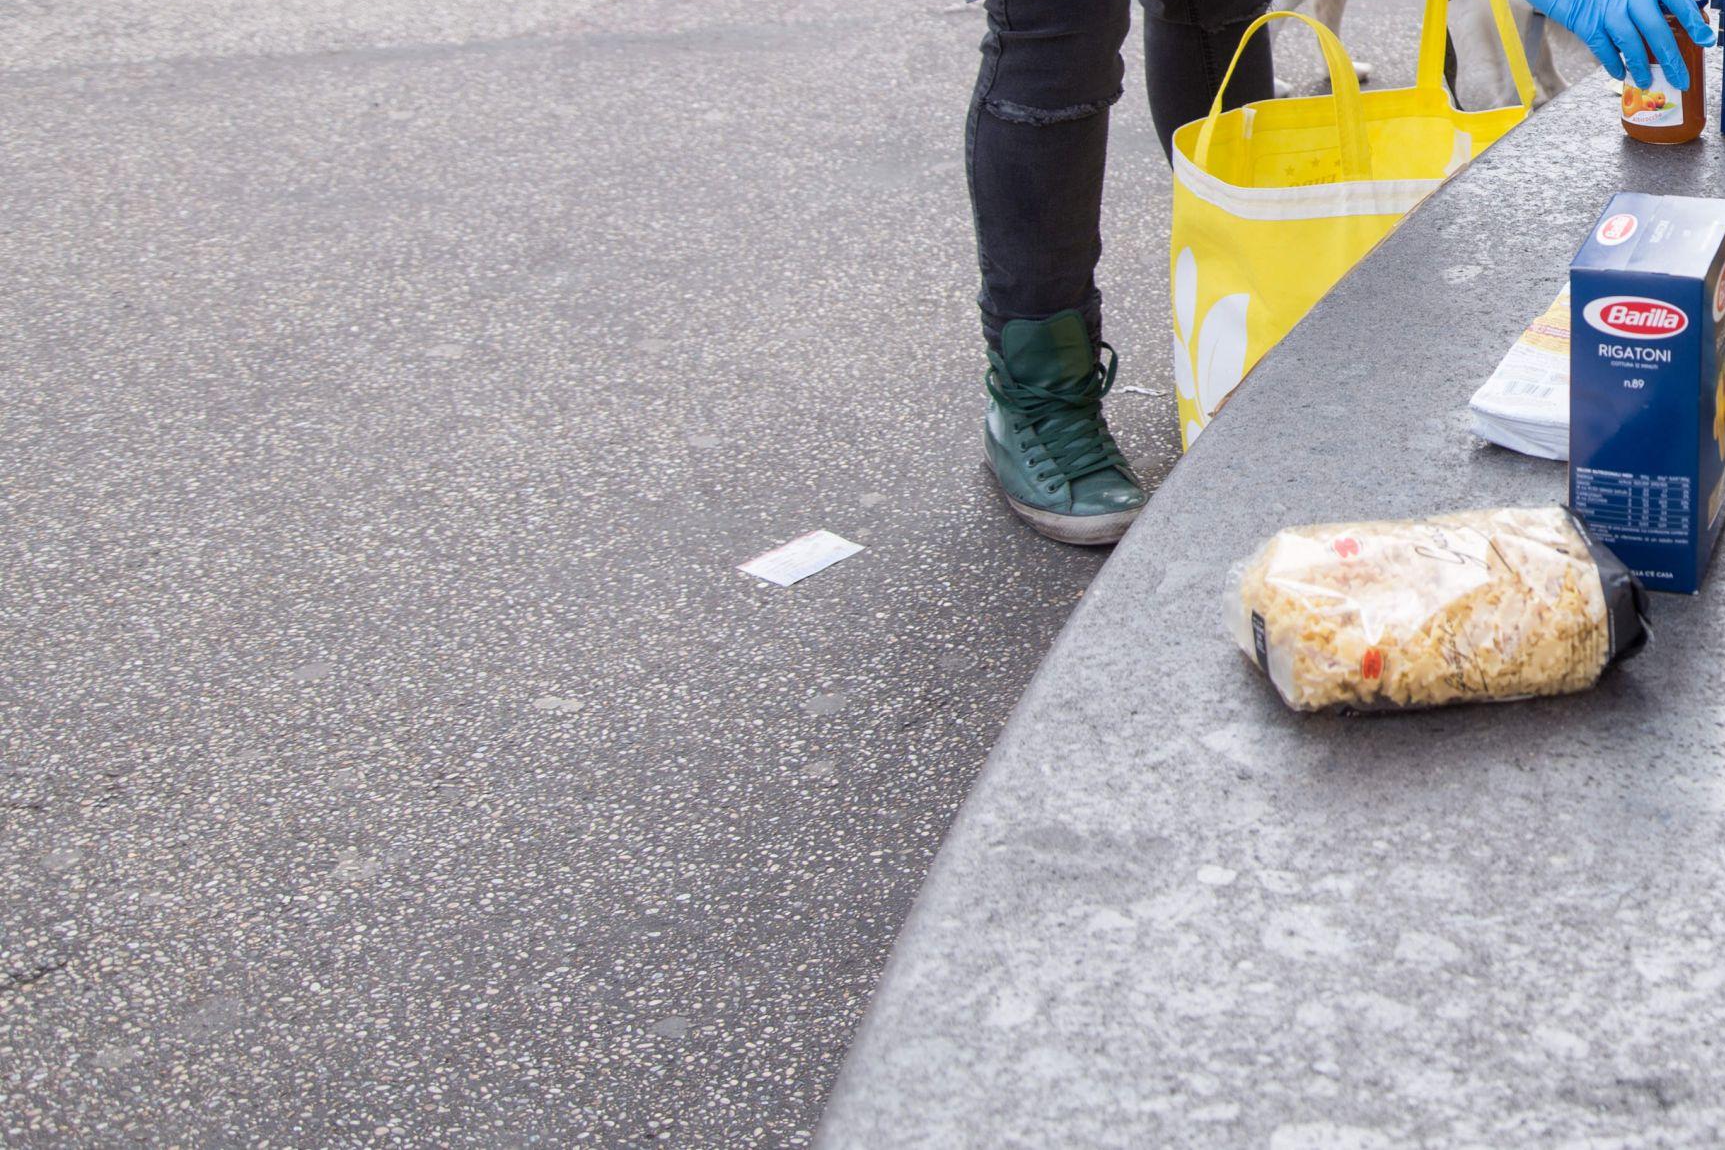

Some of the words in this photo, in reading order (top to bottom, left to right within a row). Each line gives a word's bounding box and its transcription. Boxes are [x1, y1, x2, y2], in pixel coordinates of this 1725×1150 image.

[1607, 305, 1679, 329] Barilla
[1598, 343, 1671, 363] RIGATONI
[1623, 378, 1645, 389] n.89
[1656, 570, 1674, 579] CASA
